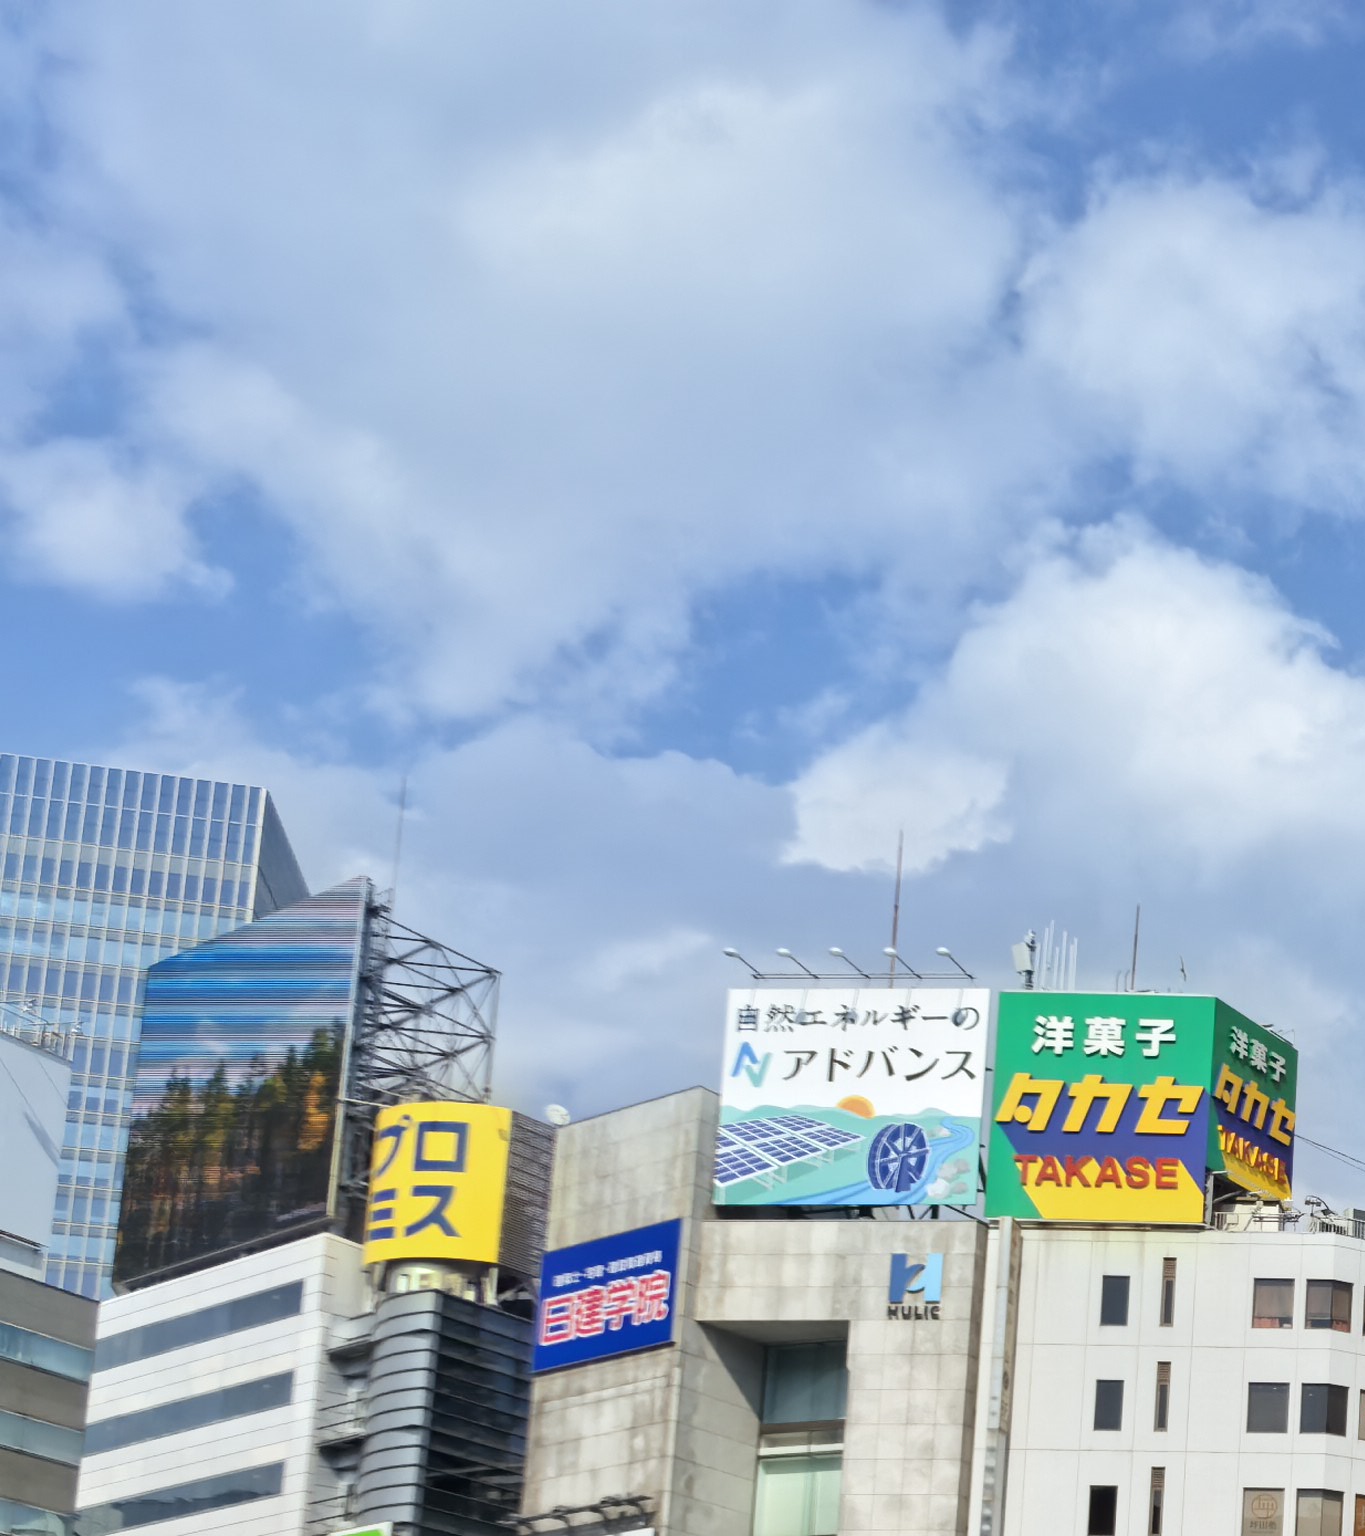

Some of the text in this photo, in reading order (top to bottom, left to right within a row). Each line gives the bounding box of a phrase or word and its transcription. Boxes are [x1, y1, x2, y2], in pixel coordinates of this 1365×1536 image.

[736, 1004, 981, 1033] 自然エネルギーの
[1031, 1015, 1177, 1058] 洋菓子
[783, 1046, 977, 1084] アドバンス
[1230, 1025, 1286, 1083] 洋菓子
[995, 1072, 1205, 1136] タカセ
[1213, 1063, 1296, 1146] タカセ
[1013, 1153, 1180, 1190] TAKASE
[1217, 1125, 1286, 1184] TAKASE
[538, 1269, 671, 1346] 日建学院
[886, 1304, 941, 1321] HULIC
